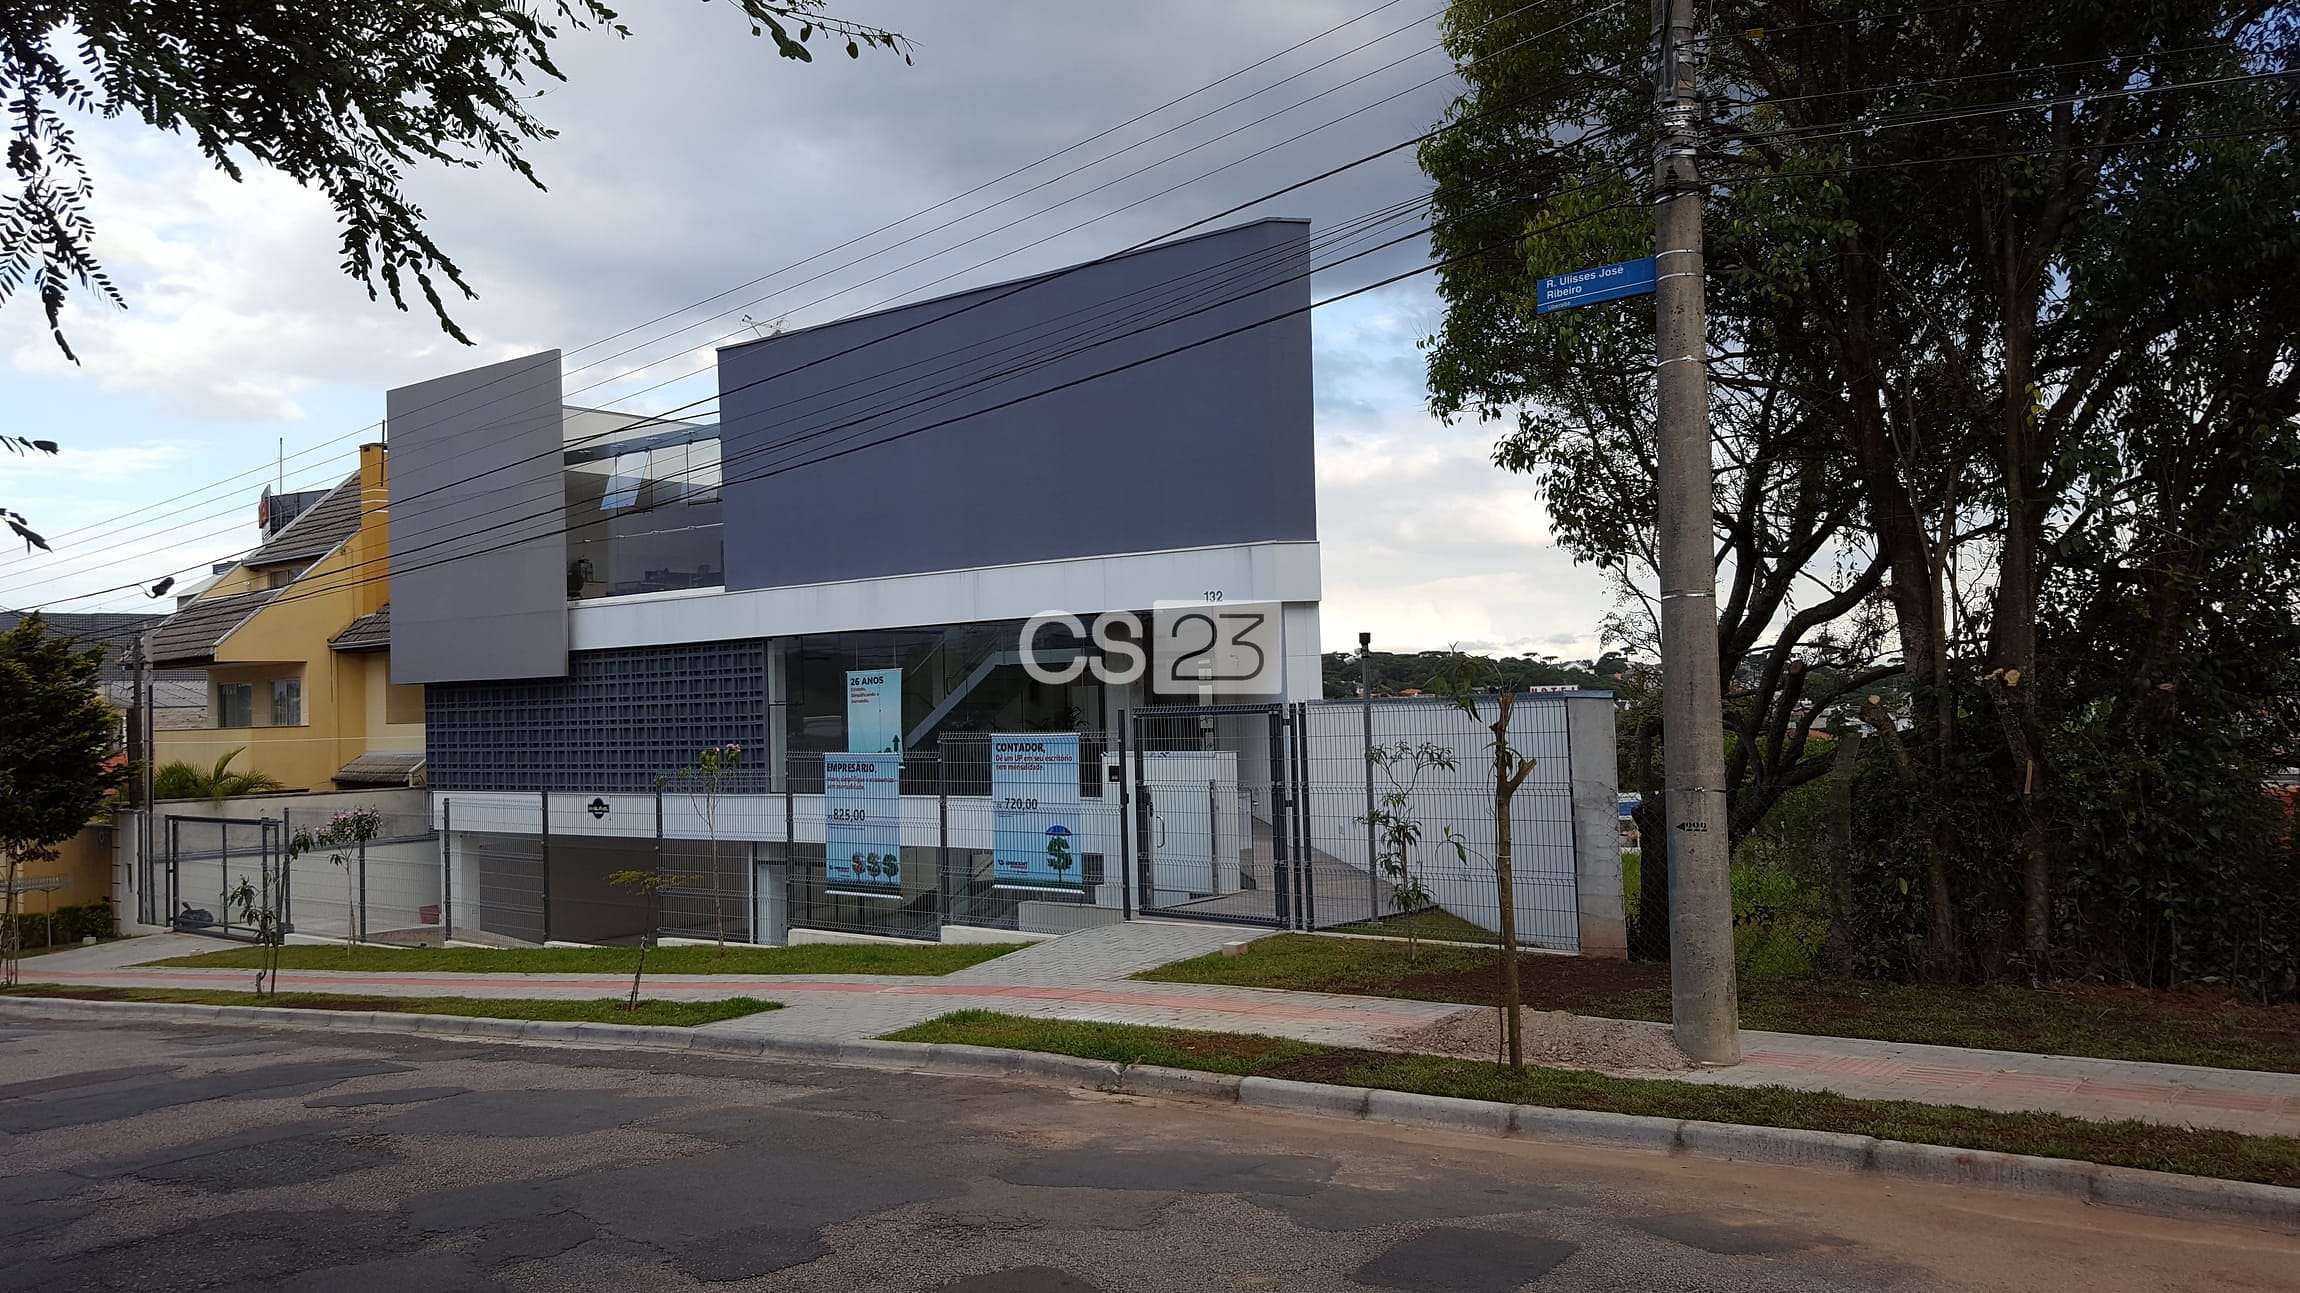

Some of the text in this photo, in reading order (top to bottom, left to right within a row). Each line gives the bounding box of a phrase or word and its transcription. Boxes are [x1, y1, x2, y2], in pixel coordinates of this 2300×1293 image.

[1546, 264, 1624, 289] R. Ulisses José
[1546, 285, 1582, 300] Ribeiro
[1203, 591, 1223, 602] 132
[850, 676, 884, 686] 26 ANOS
[995, 743, 1046, 753] CONTADOR,
[1004, 797, 1038, 811] 720,00
[833, 808, 866, 822] 825,00
